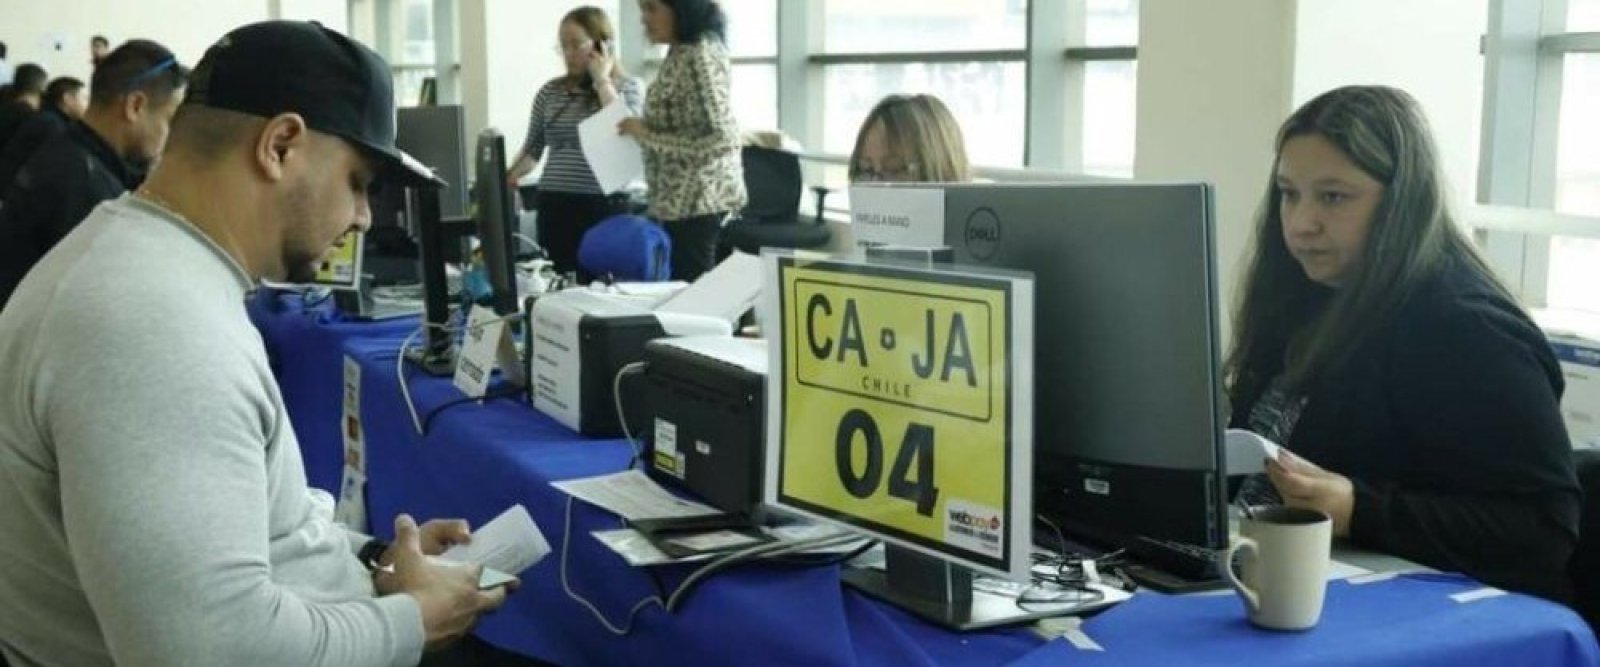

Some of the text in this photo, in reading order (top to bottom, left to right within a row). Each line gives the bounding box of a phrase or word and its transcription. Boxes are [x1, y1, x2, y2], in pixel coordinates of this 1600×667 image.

[969, 226, 998, 242] DELL
[807, 293, 977, 388] CA JA
[861, 375, 912, 398] CHILE
[835, 408, 939, 517] 04
